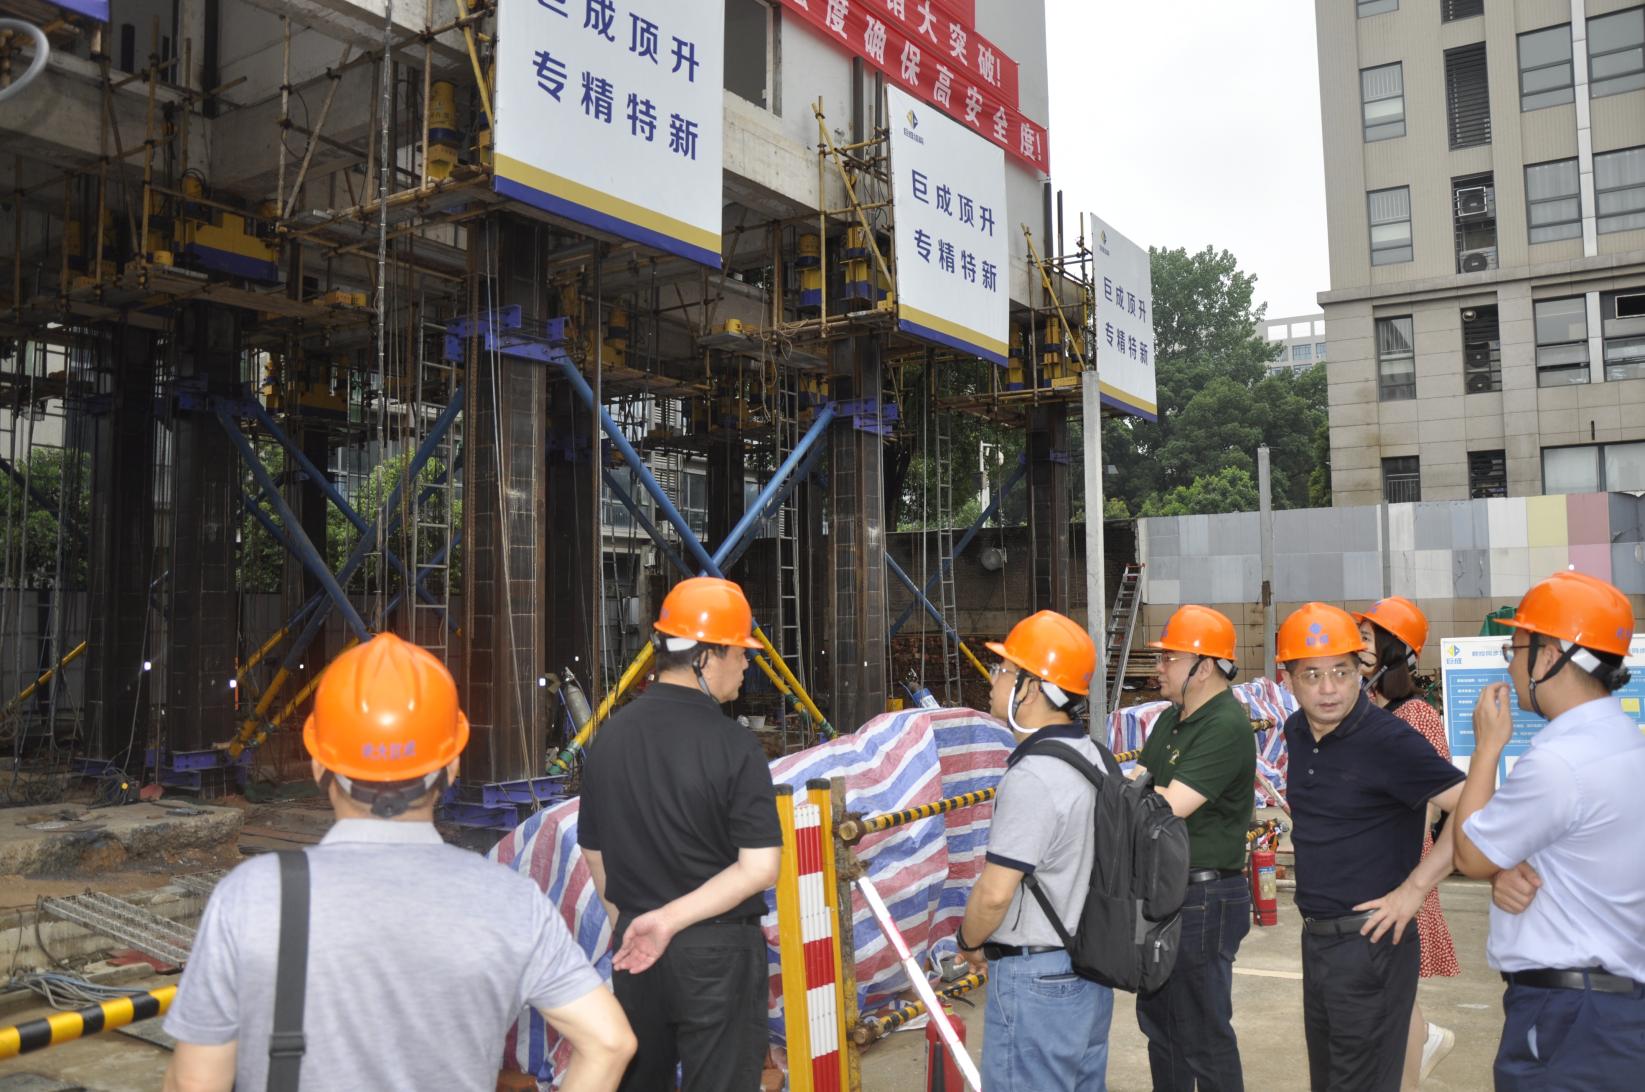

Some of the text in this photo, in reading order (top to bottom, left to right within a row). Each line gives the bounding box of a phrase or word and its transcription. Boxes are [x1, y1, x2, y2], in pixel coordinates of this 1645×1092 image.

[532, 50, 699, 161] 专精特新
[793, 0, 1042, 161] 度确保高安全度!
[911, 169, 996, 237] 巨成顶升
[914, 229, 998, 293] 专精特新
[1103, 276, 1147, 324] 巨成顶升
[1104, 322, 1149, 366] 专精特新
